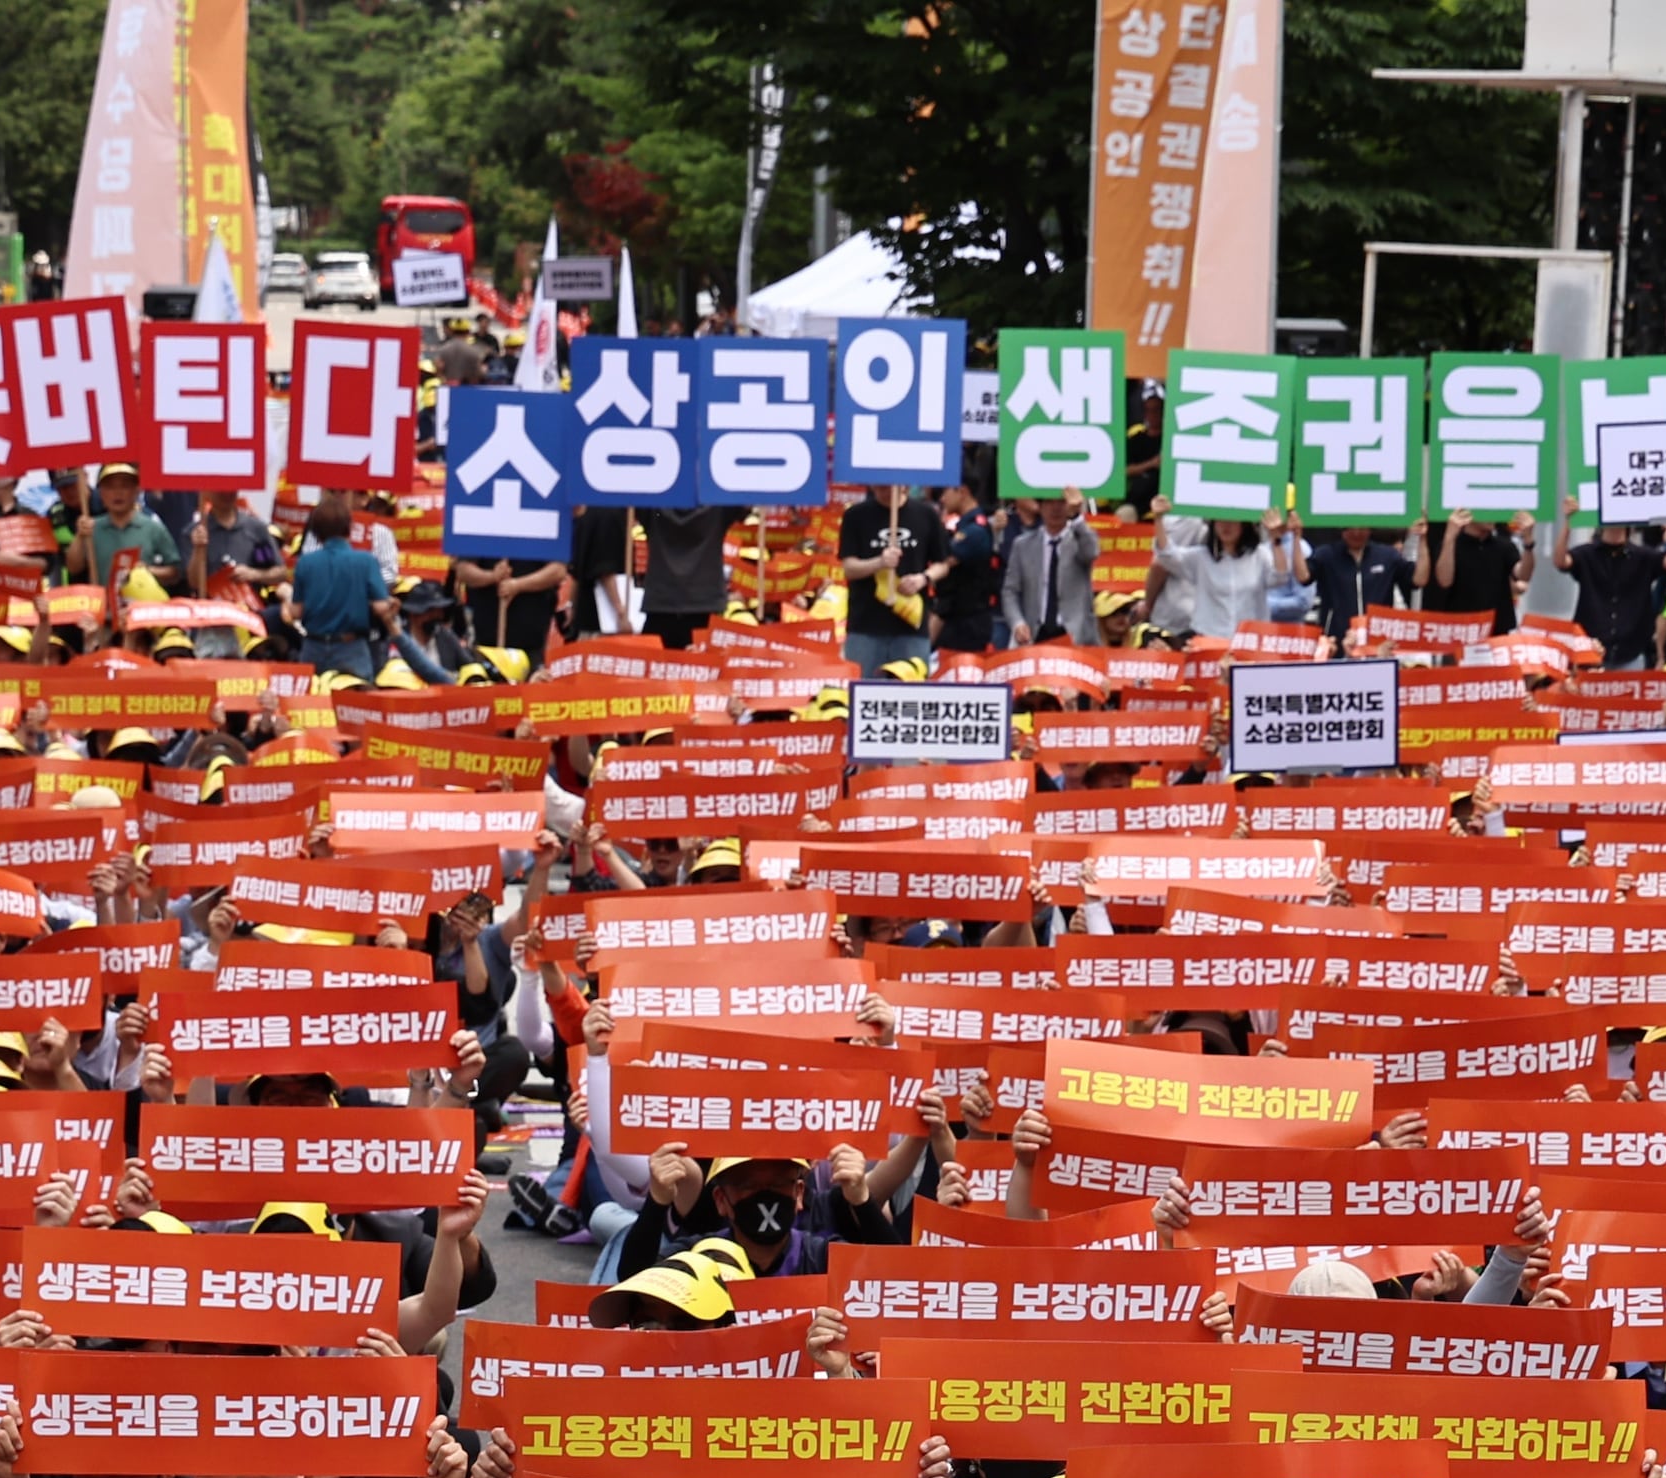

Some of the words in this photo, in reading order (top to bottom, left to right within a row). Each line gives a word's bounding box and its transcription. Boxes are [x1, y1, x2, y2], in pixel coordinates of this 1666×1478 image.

[454, 327, 948, 540] 소상공인
[1006, 346, 1546, 516] 생존권을
[526, 699, 608, 730] 근로기준법
[609, 697, 643, 717] 확대
[645, 693, 691, 715] 저지!!
[859, 699, 1002, 722] 전북특별자치도
[1243, 690, 1385, 719] 전북특별자치도
[859, 722, 1002, 747] 소상공인연합회
[1039, 726, 1110, 748] 생존권을
[1114, 725, 1201, 747] 보장하라!!
[1243, 718, 1385, 745] 소상공인연합회
[1489, 762, 1576, 786] 생존권을
[335, 810, 407, 830] 대형마트
[410, 811, 482, 832] 새벽배송
[485, 811, 538, 832] 반대!!
[1094, 856, 1191, 879] 생존권을
[1198, 857, 1317, 879] 보장하라!!
[1058, 1067, 1189, 1114] 고용정책
[1198, 1084, 1359, 1122] 전환하라!!
[150, 1135, 285, 1173] 생존권을
[296, 1139, 462, 1175] 보장하라!!
[522, 1415, 692, 1459] 고용정책
[706, 1416, 913, 1462] 전환하라!!
